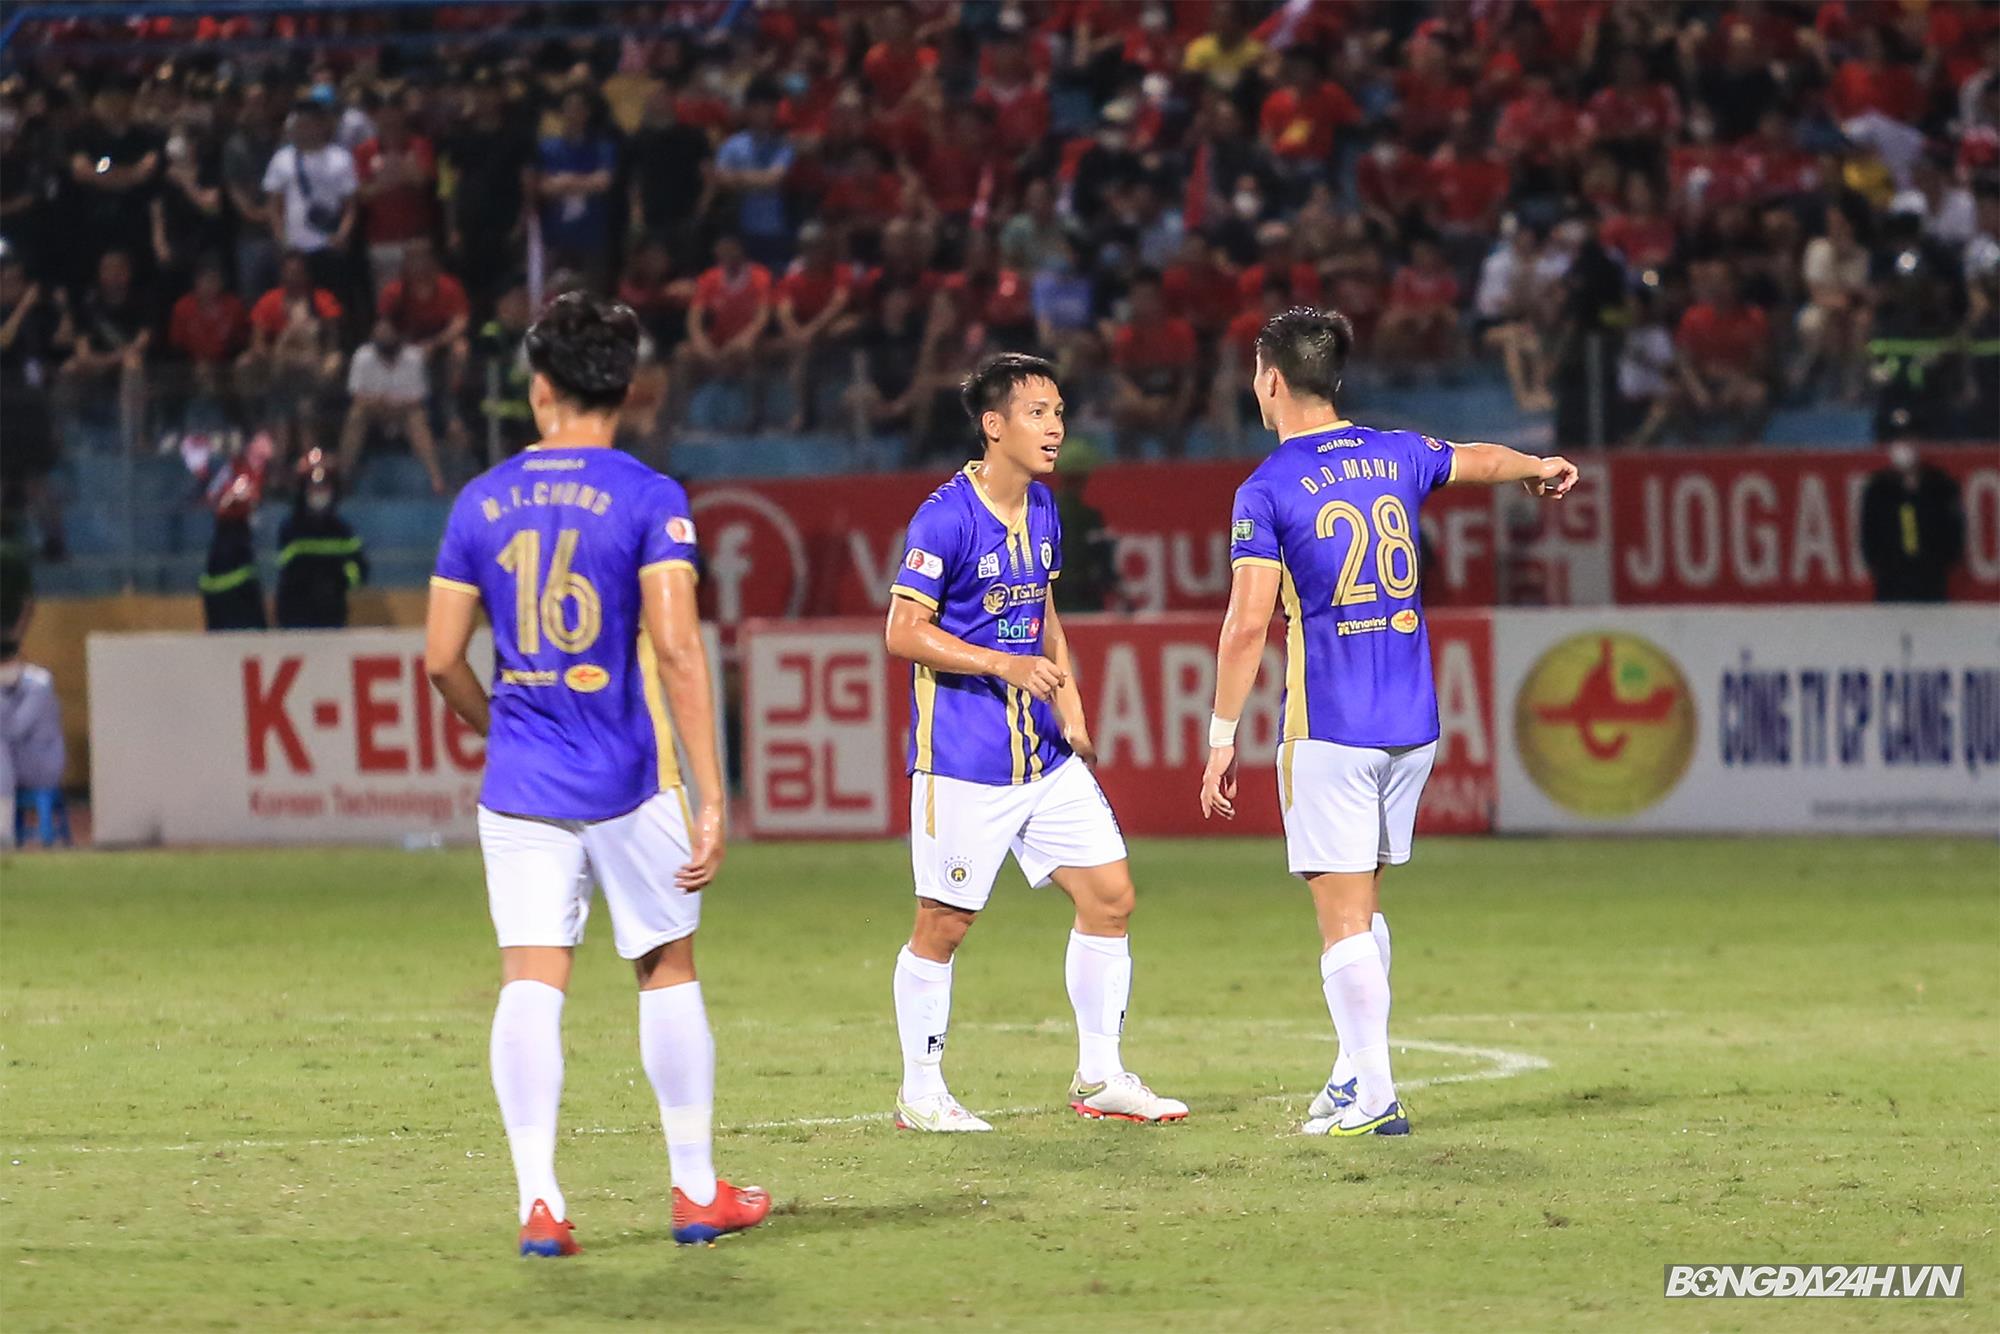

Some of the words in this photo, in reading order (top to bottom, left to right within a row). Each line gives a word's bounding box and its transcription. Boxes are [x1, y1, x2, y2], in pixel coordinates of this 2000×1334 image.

[1315, 495, 1419, 607] 28
[1626, 471, 2000, 586] JOGAO
[496, 529, 602, 655] 16
[766, 652, 873, 724] JG
[766, 741, 876, 813] BL
